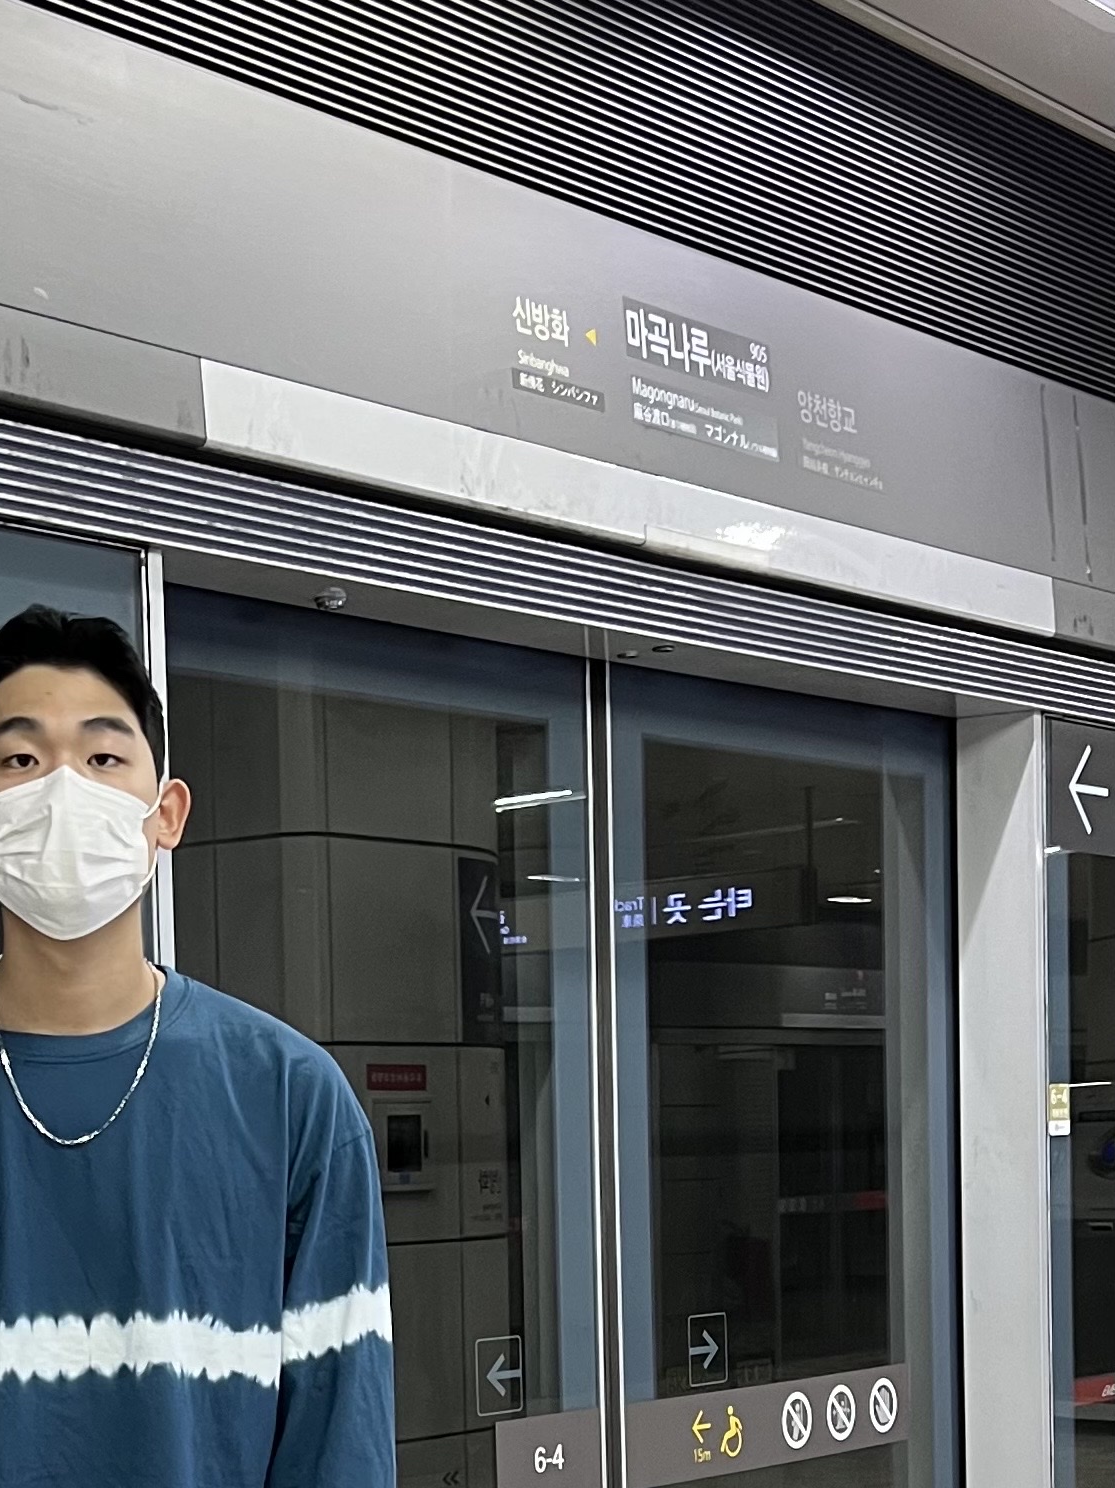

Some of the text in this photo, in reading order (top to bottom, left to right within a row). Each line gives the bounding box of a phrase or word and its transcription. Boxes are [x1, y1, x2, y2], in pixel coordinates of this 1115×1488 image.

[512, 296, 570, 347] 신방화
[797, 390, 858, 434] 양천향교
[534, 1443, 565, 1474] 6-4
[693, 1447, 712, 1464] 15m
